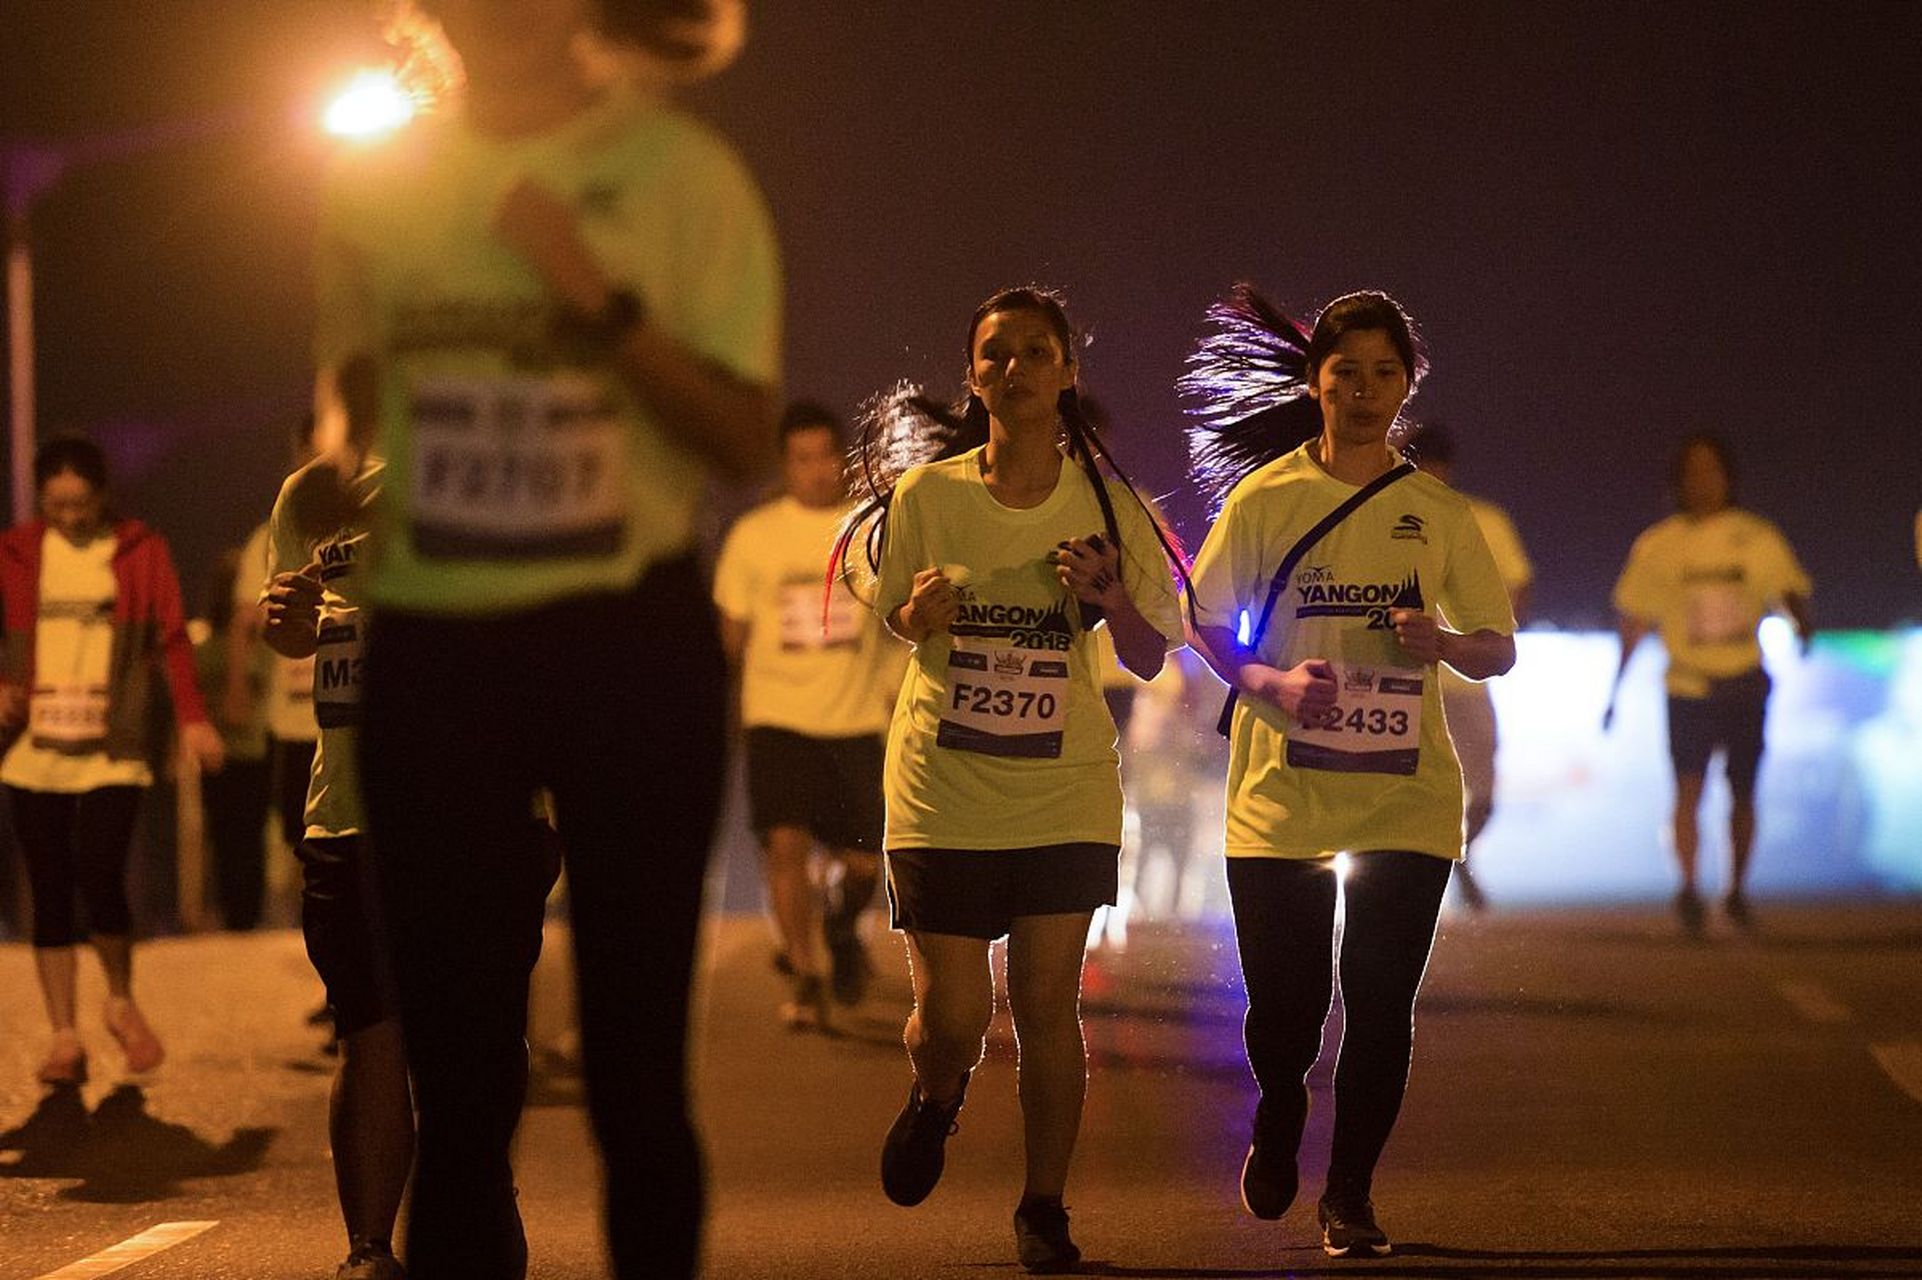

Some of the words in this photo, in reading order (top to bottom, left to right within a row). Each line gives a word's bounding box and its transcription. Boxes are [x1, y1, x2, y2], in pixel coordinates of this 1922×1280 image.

[1298, 583, 1400, 605] YANGON
[956, 604, 1043, 624] ANGON
[1011, 630, 1071, 652] 2018
[952, 683, 1056, 719] F2370
[1302, 706, 1409, 736] 2433
